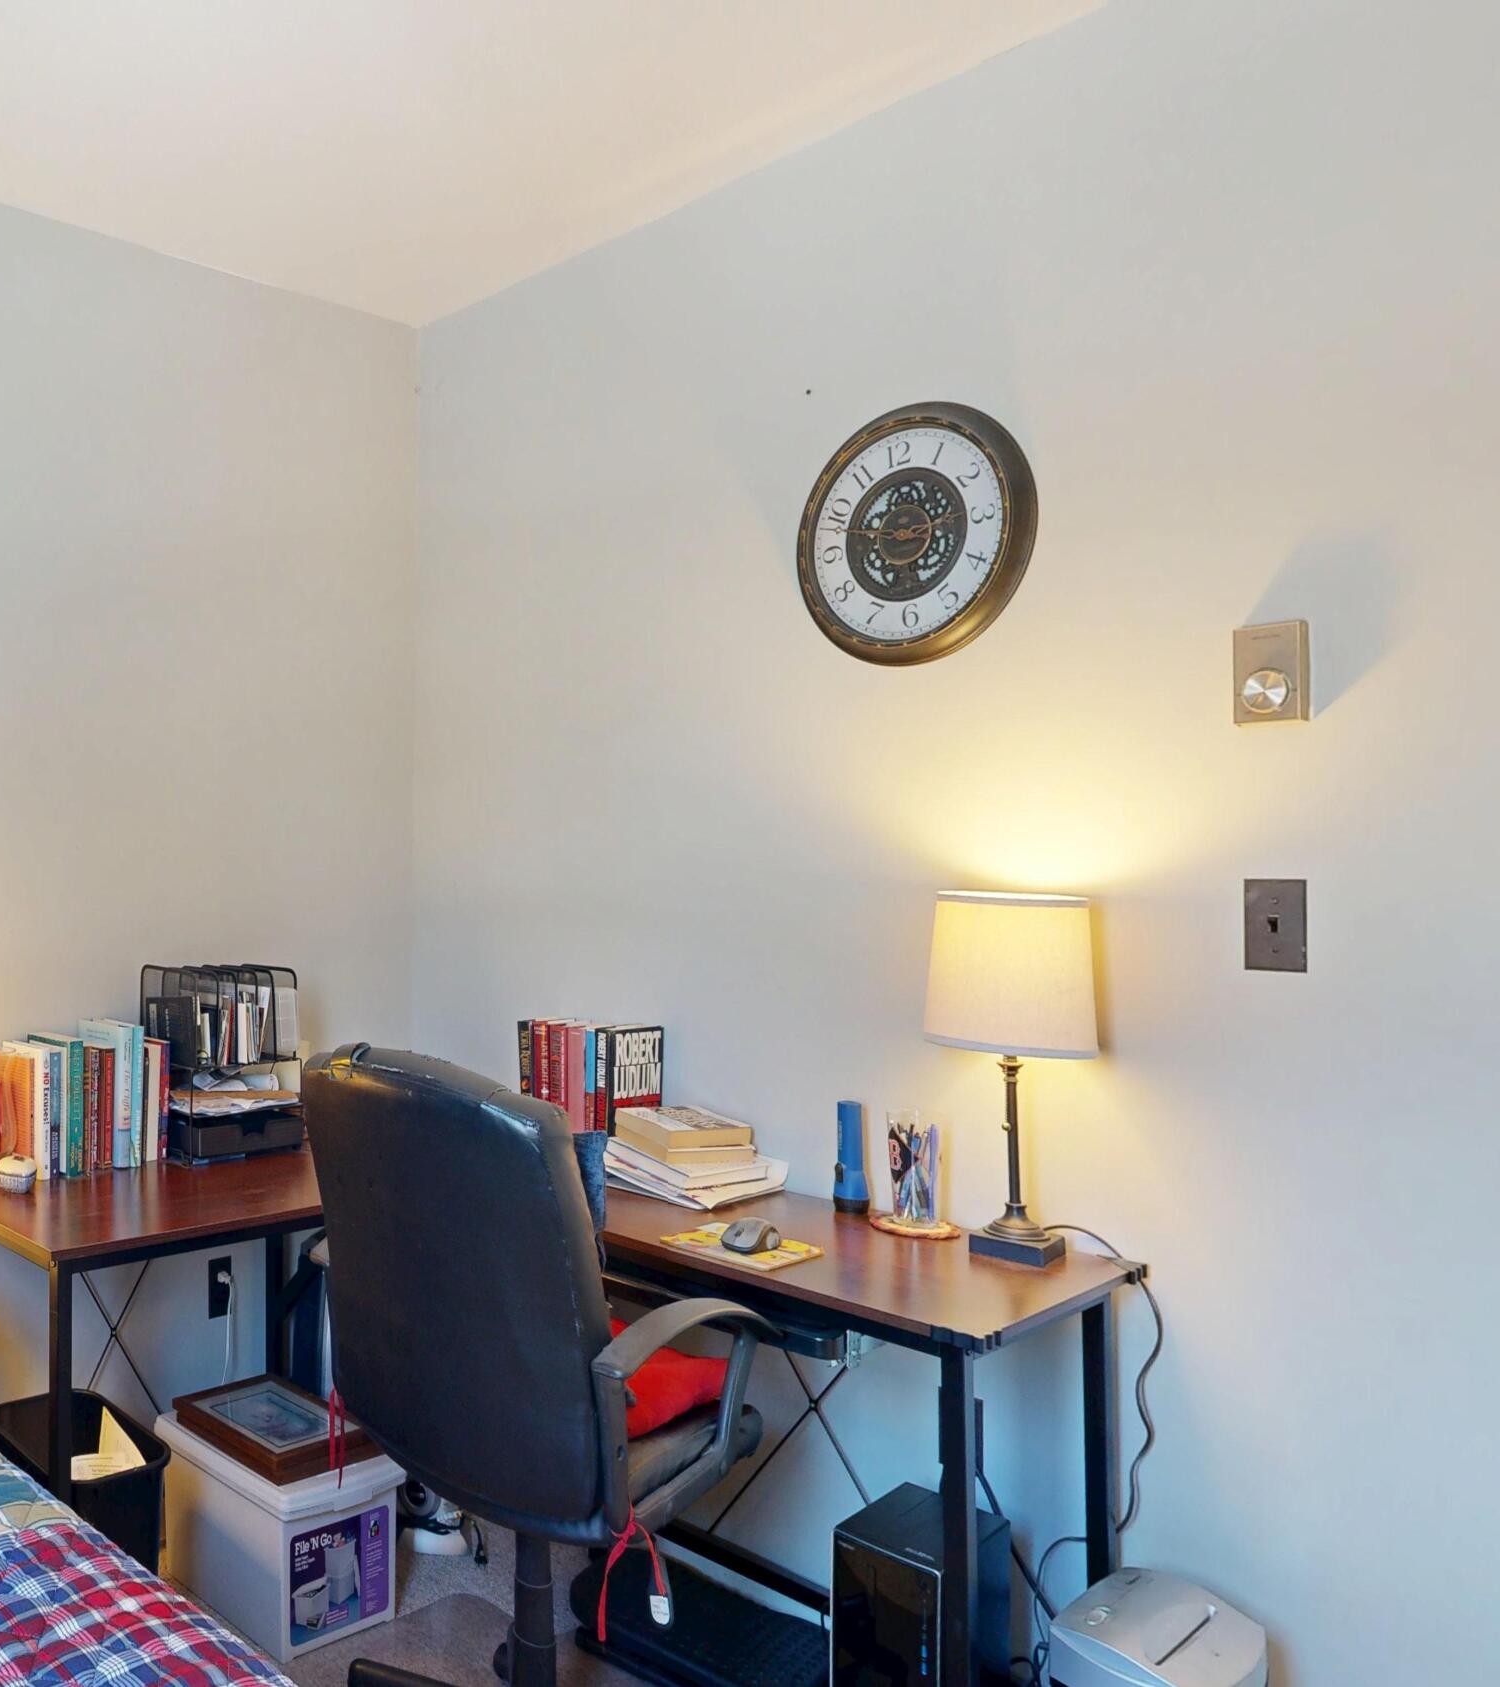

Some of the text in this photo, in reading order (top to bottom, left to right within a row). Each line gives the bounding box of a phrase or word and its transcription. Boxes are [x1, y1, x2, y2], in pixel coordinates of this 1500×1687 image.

[886, 440, 912, 468] 12
[930, 441, 945, 466] 1
[851, 464, 875, 491] 11
[955, 461, 981, 488] 2
[828, 497, 851, 525] 10
[970, 503, 996, 524] 3
[822, 545, 844, 565] 9
[965, 550, 987, 571] 4
[833, 579, 856, 603] 8
[937, 583, 960, 611] 5
[866, 601, 885, 625] 7
[902, 603, 919, 628] 6
[597, 1032, 607, 1059] ROBERT
[615, 1030, 662, 1066] ROBERT
[43, 1072, 50, 1085] NO
[597, 1059, 607, 1088] LUDLUM
[613, 1062, 662, 1099] LUDLUM
[888, 1139, 902, 1171] B
[294, 1540, 311, 1556] File
[320, 1532, 333, 1547] Go
